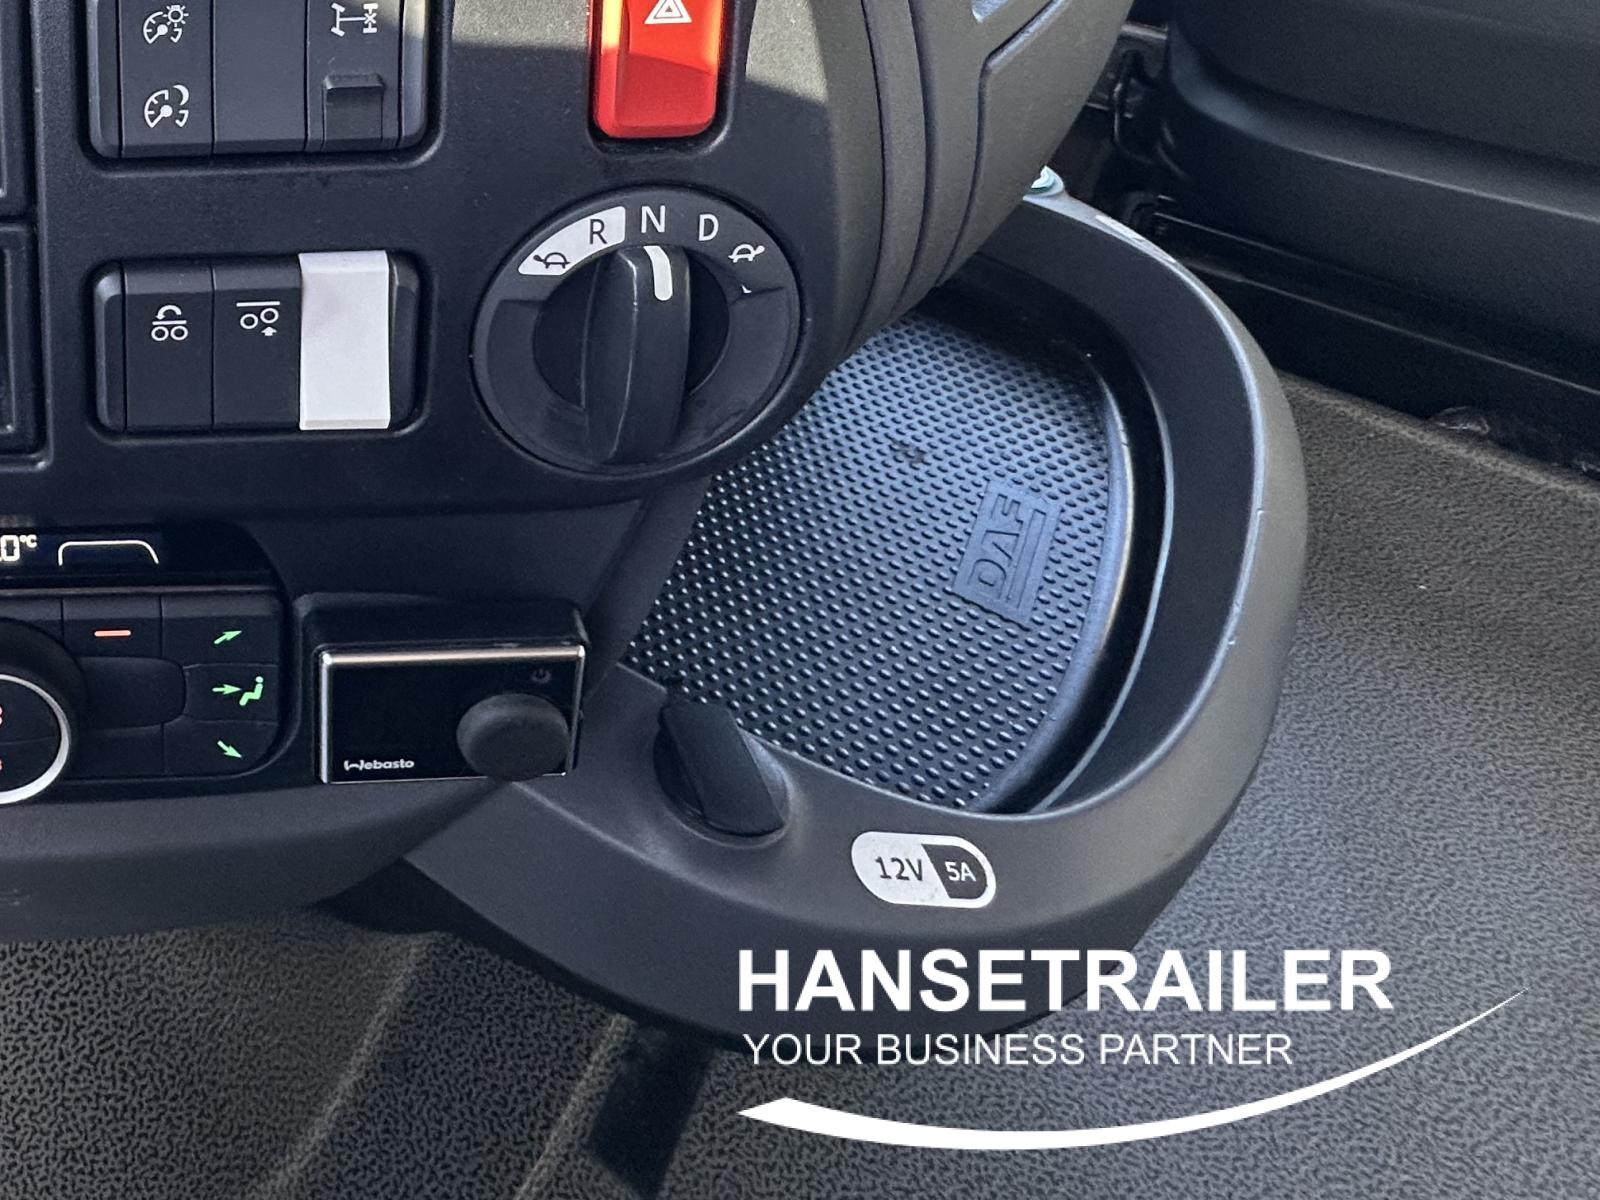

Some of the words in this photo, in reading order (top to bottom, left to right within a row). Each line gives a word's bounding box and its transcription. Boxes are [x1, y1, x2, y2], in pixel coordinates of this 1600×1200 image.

[588, 218, 608, 245] R
[640, 204, 667, 234] N
[698, 213, 720, 242] D
[965, 492, 1026, 602] DAF
[343, 758, 415, 772] Webasto
[874, 855, 924, 883] 12V
[944, 860, 977, 883] 5A
